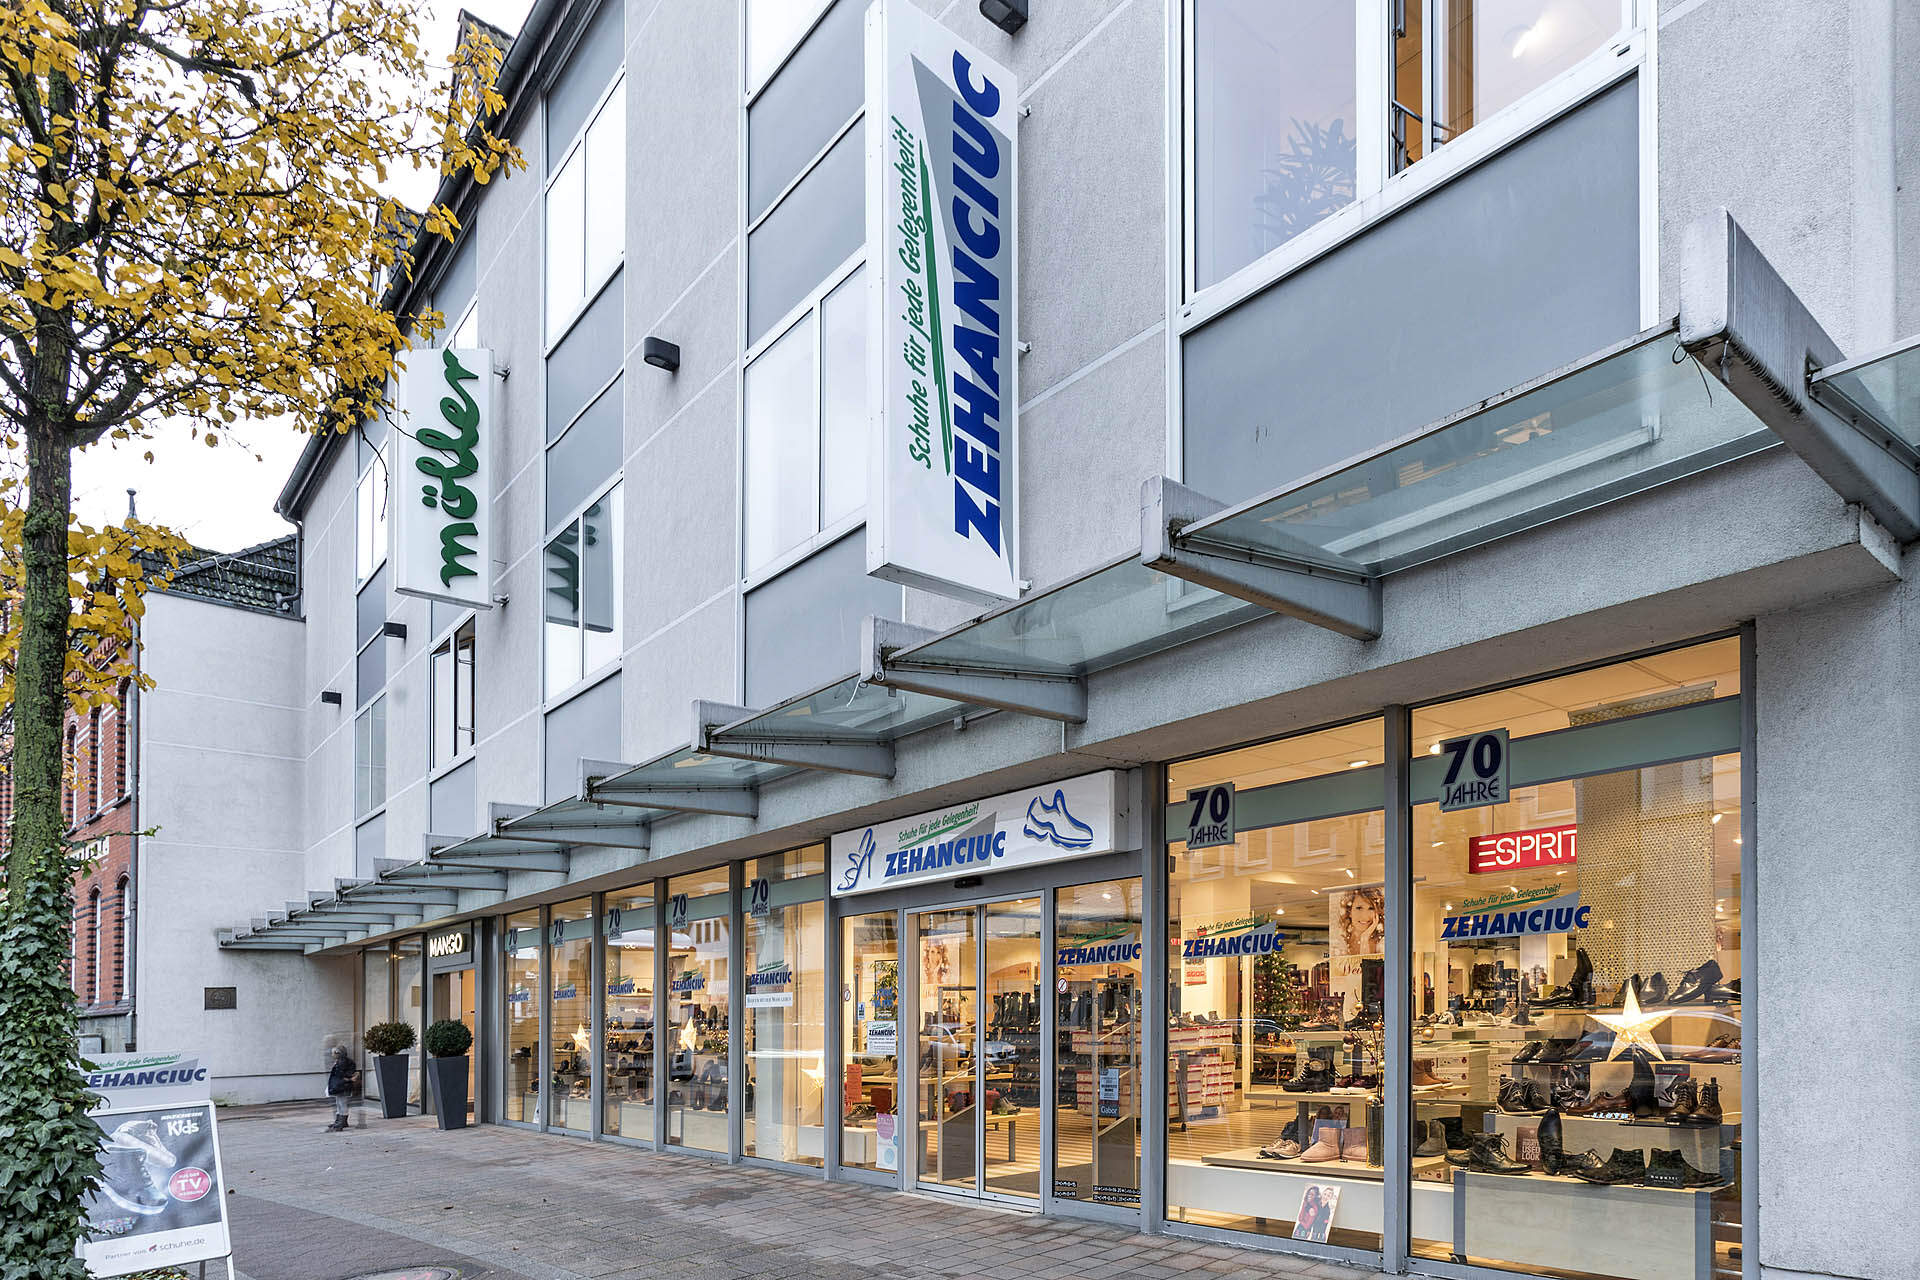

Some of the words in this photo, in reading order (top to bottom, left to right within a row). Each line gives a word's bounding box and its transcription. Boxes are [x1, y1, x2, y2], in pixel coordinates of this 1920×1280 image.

[890, 115, 927, 275] Gelegenheit!
[900, 278, 931, 343] jede
[952, 49, 1001, 559] ZEHANCIUC
[904, 335, 927, 378] für
[908, 380, 932, 470] Schuhe
[415, 349, 480, 588] möller
[1443, 735, 1501, 785] 70
[1442, 778, 1500, 806] JAHRE
[1188, 787, 1230, 828] 70
[898, 827, 918, 843] Schuhe
[928, 816, 941, 834] jede
[942, 802, 980, 827] Gelegenheit!
[1188, 823, 1228, 846] JAHRE
[884, 830, 1007, 878] ZEHANCIUC
[1478, 829, 1577, 868] ESPRIT
[672, 893, 687, 918] 70
[750, 878, 769, 906] 70
[1463, 897, 1488, 908] Schuhe
[1488, 893, 1500, 905] für
[1500, 891, 1515, 905] jede
[1516, 882, 1561, 901] Gelegenheit!
[554, 919, 564, 939] 70
[608, 908, 621, 929] 70
[1440, 905, 1591, 939] ZEHANCIUC
[429, 932, 463, 958] MANGO
[1057, 943, 1142, 965] ZEHANCIUC
[1183, 933, 1285, 958] ZEHANCIUC
[608, 983, 635, 995] ZEHANCIUC
[672, 977, 705, 992] ZEHANCIUC
[751, 971, 793, 986] ZEHANCIUC
[176, 1177, 202, 1192] TV
[159, 1238, 206, 1252] schuhe.de
